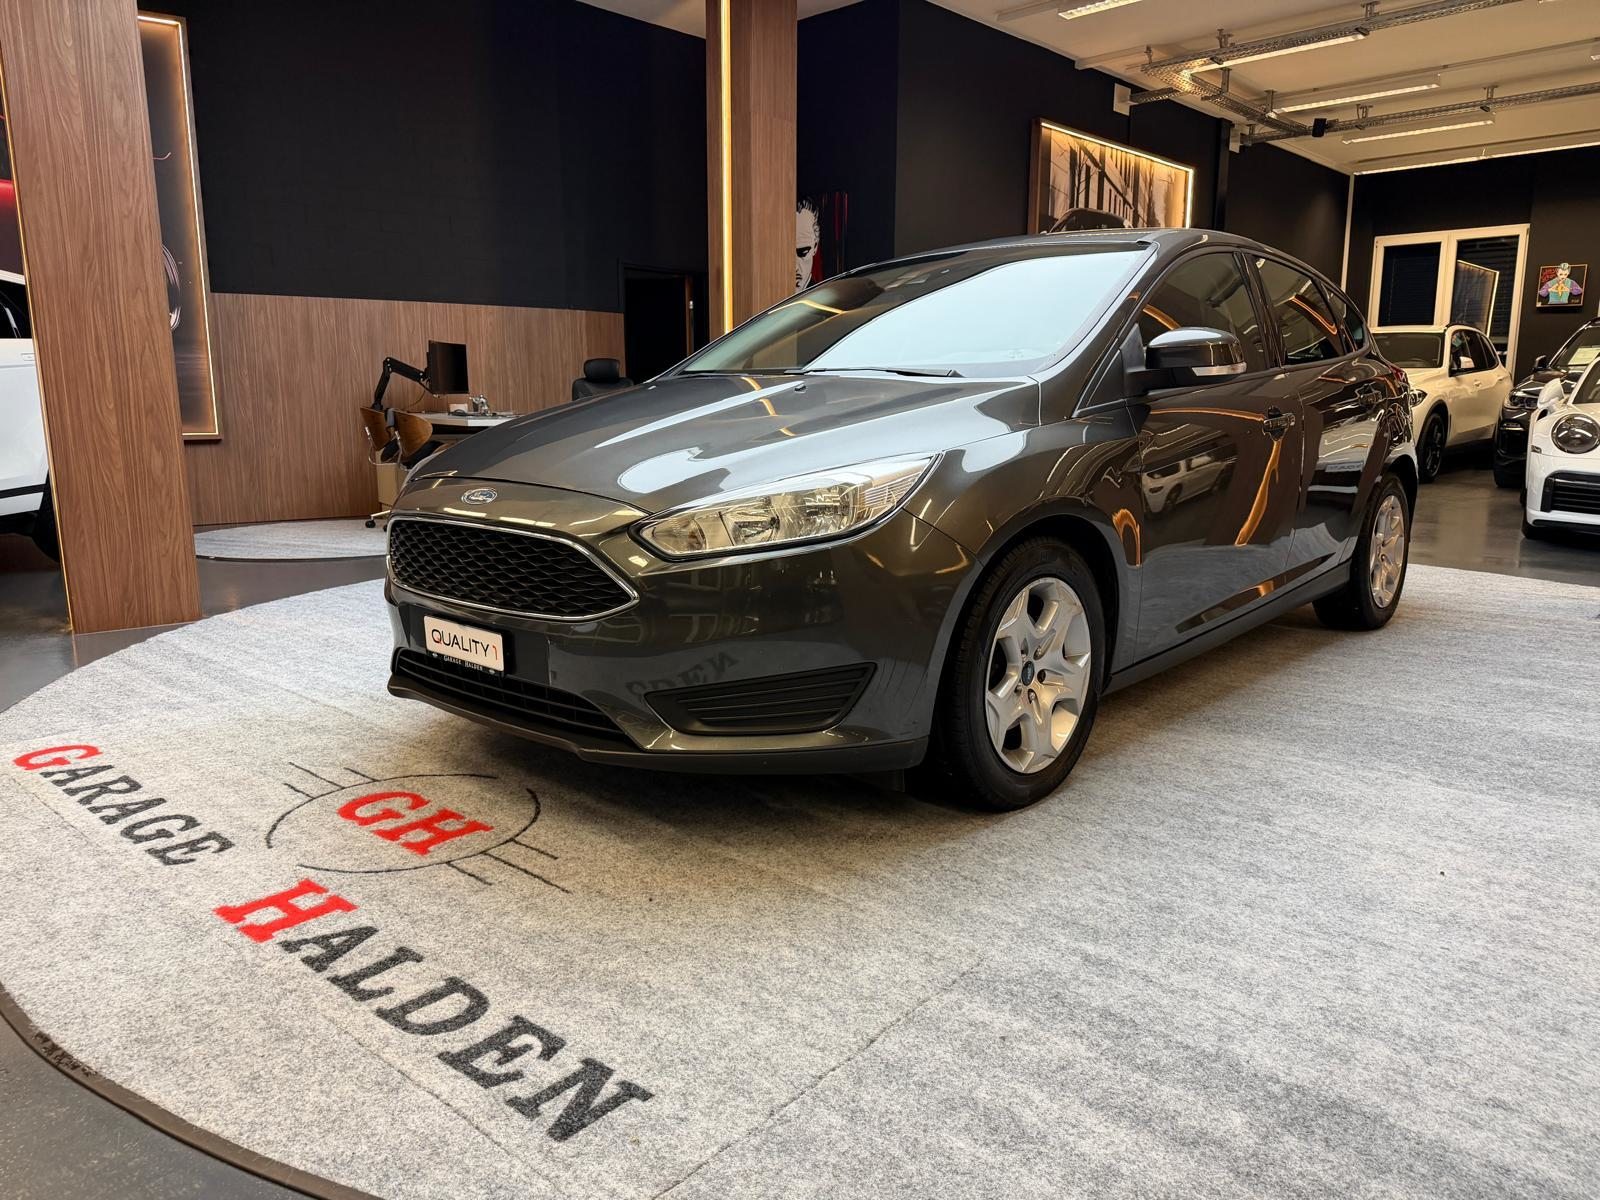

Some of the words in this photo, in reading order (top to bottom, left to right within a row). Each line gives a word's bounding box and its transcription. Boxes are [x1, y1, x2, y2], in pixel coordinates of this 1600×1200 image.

[336, 790, 494, 856] GH
[13, 744, 235, 866] GARAGE
[213, 879, 654, 1141] HALDEN
